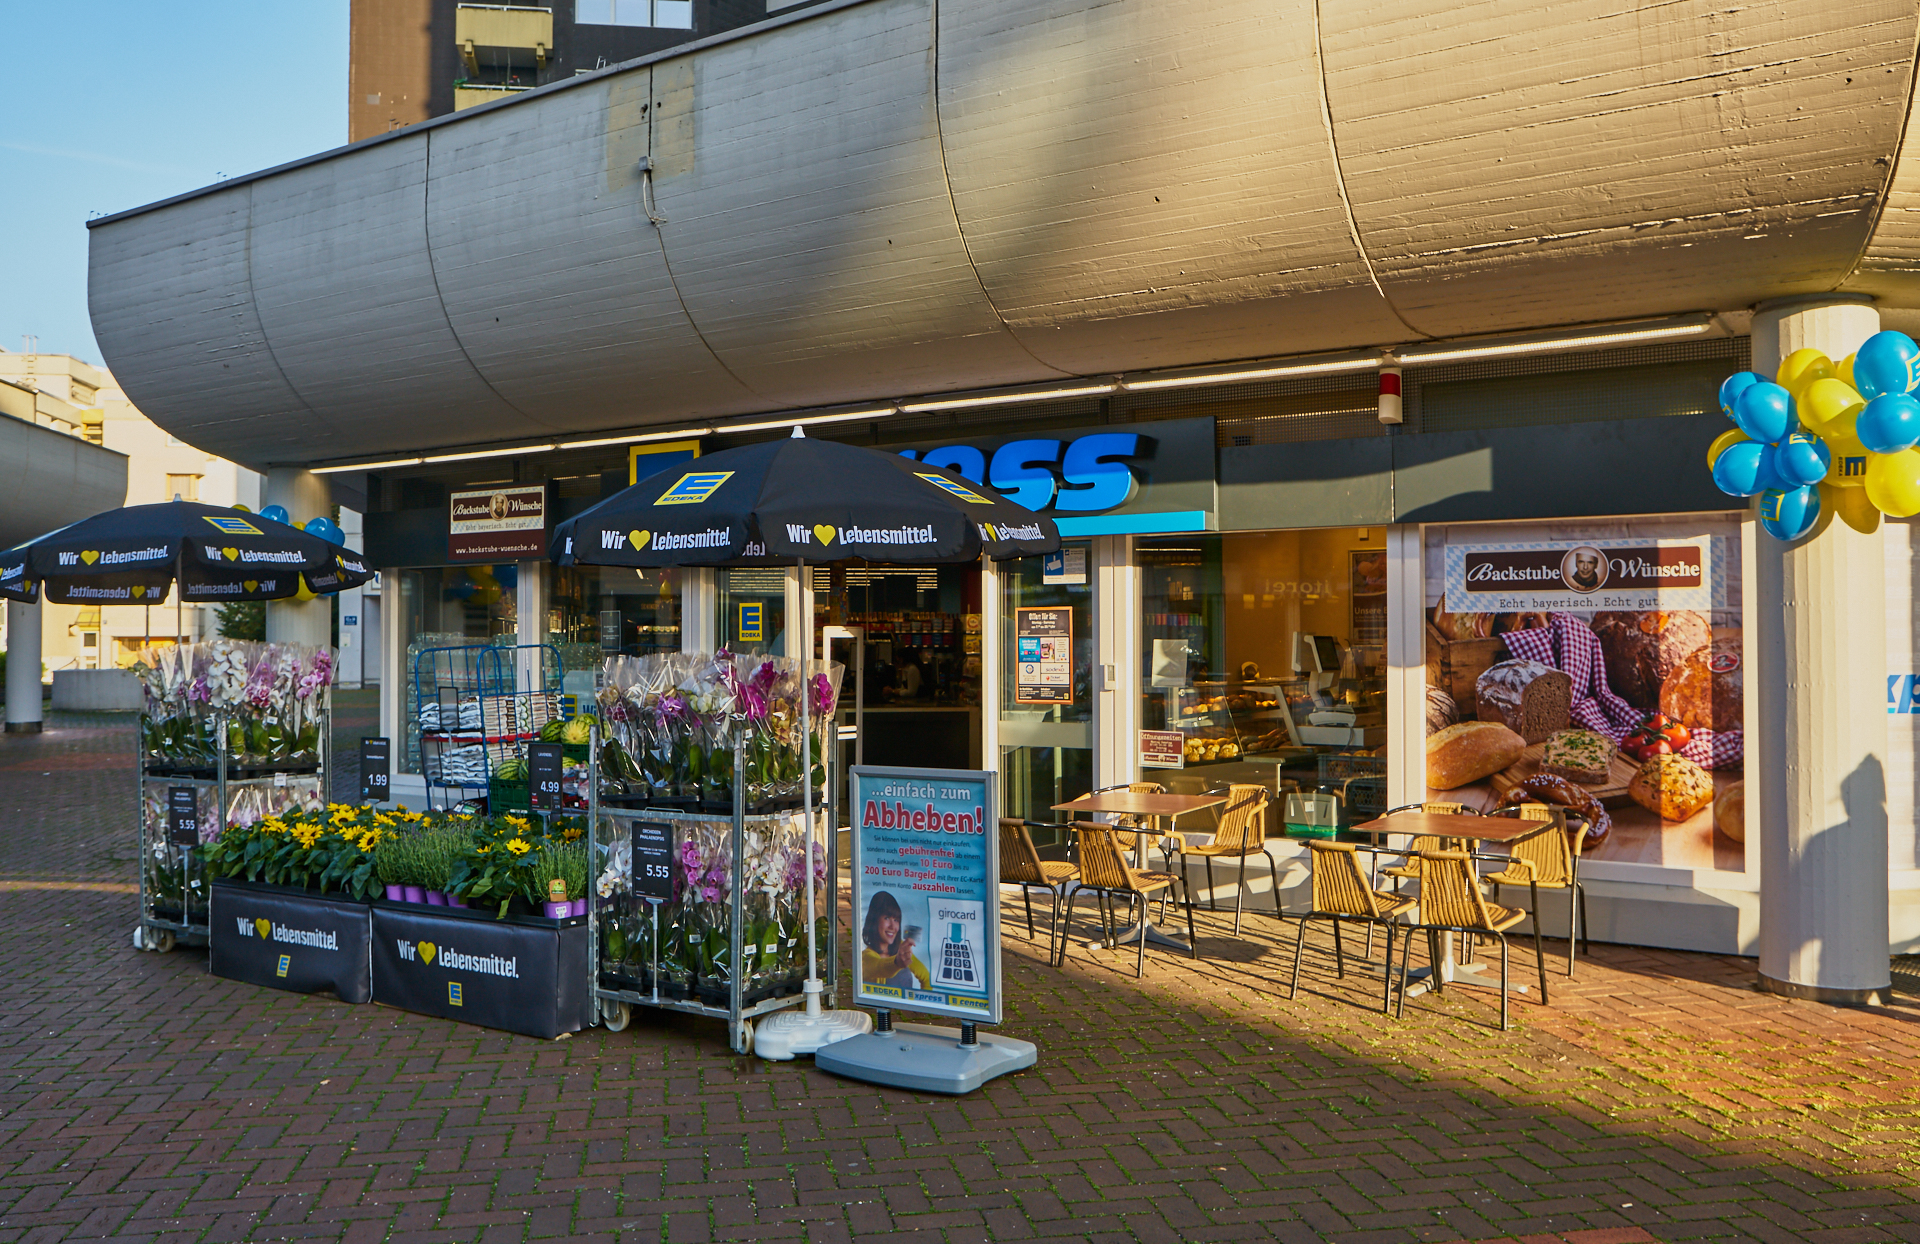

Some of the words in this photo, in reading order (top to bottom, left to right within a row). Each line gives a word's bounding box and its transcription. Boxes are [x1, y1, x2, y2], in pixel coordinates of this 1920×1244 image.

[453, 503, 490, 516] Backstube
[507, 498, 542, 512] Wünsche
[601, 529, 627, 550] Wir
[651, 527, 731, 551] Lebensmittel.
[785, 523, 811, 544] Wir
[838, 524, 938, 546] Lebensmittel.
[58, 552, 79, 565] Wir
[99, 545, 169, 565] Lebensmittel.
[204, 546, 222, 561] Wir
[239, 549, 307, 564] Lebensmittel.
[455, 543, 538, 554] www.backstube-wuensche.de
[1466, 562, 1561, 582] Backstube
[1609, 556, 1700, 578] Wünsche
[1354, 606, 1382, 615] Unsere
[1499, 598, 1526, 608] Echt
[1532, 597, 1599, 611] bayerisch.
[1603, 597, 1634, 608] Echt
[1638, 598, 1665, 610] gut.
[368, 774, 388, 786] 1.99
[540, 781, 560, 793] 4.99
[871, 780, 936, 799] ...einfach
[940, 787, 971, 800] zum
[179, 819, 195, 830] 5.55
[862, 800, 984, 834] Abheben!
[882, 835, 900, 843] können
[898, 845, 955, 858] gebührenfrei
[646, 864, 669, 879] 5.55
[877, 858, 909, 866] Einkaufswert
[920, 858, 930, 868] 10
[932, 858, 953, 870] Euro
[864, 865, 880, 876] 200
[881, 866, 902, 877] Euro
[903, 867, 937, 881] Bargeld
[960, 875, 985, 884] EC-Karte
[897, 882, 912, 890] Konto
[912, 881, 956, 894] auszahlen
[938, 907, 976, 921] girocard
[237, 916, 255, 937] Wir
[272, 922, 339, 951] Lebensmittel.
[396, 938, 416, 962] Wir
[438, 944, 520, 980] Lebensmittel.
[873, 986, 899, 996] EDEKA
[960, 999, 988, 1008] center
